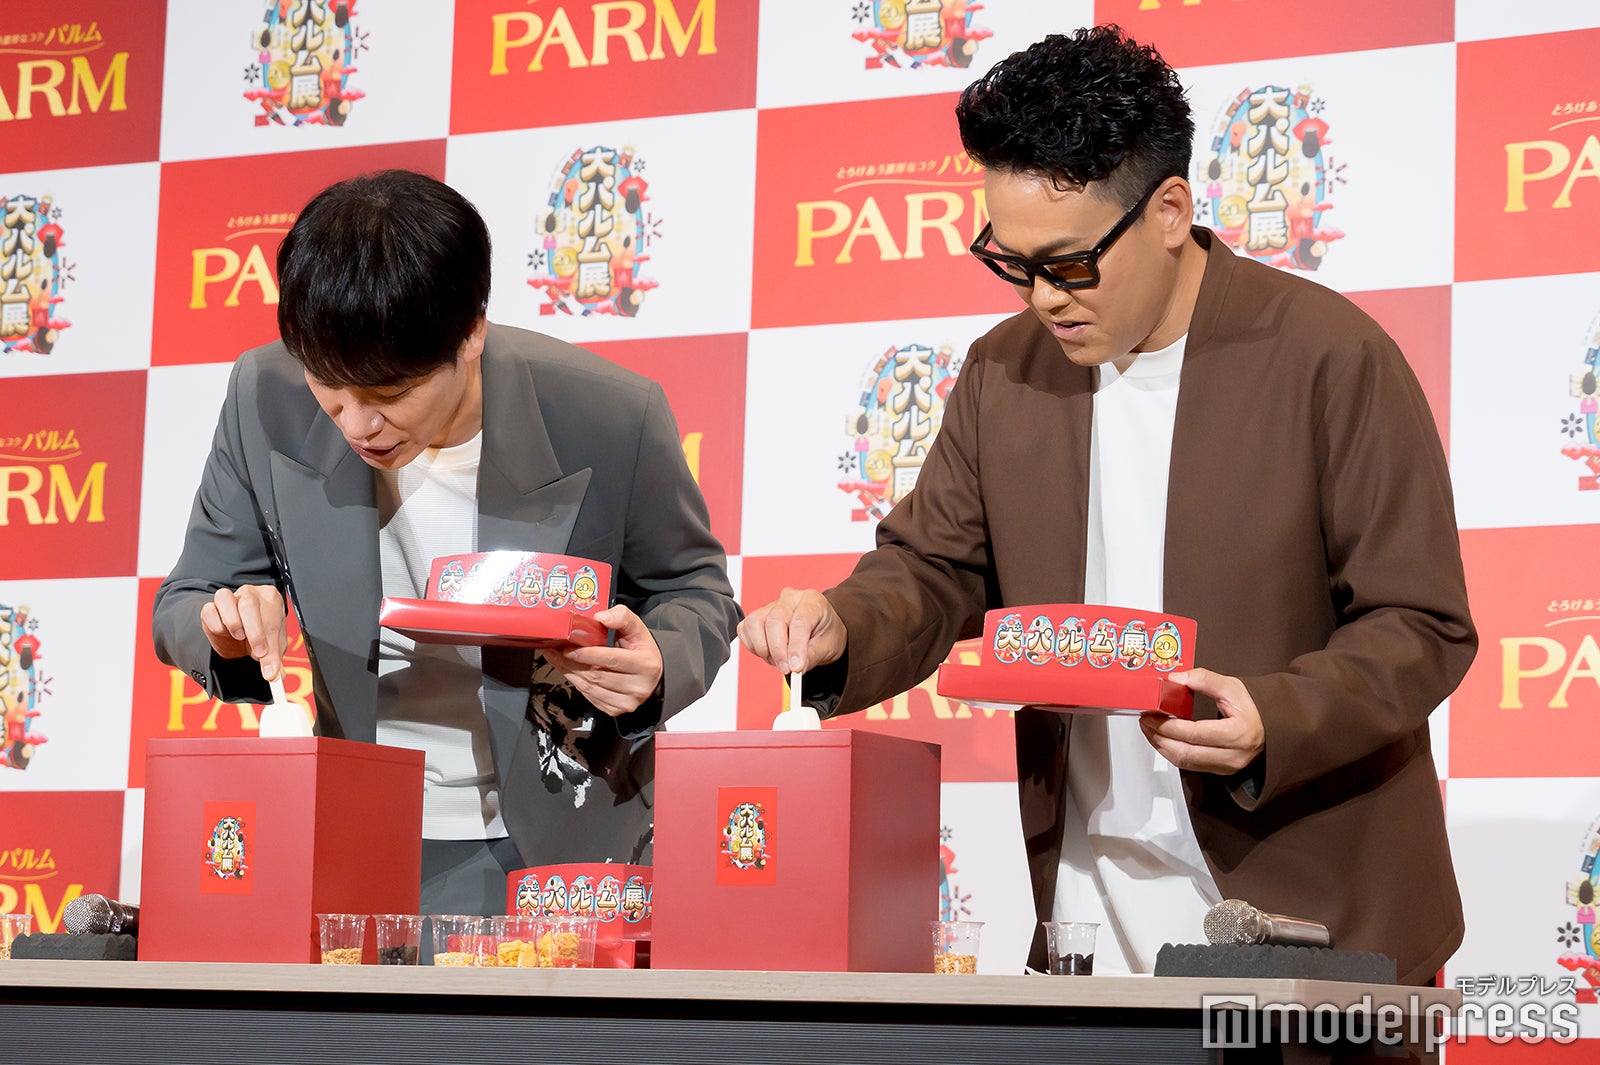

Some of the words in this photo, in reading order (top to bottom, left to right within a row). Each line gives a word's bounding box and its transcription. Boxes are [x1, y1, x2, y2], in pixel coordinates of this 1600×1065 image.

[45, 21, 102, 46] パルム
[489, 0, 718, 76] PARM
[0, 52, 129, 122] RM
[1247, 86, 1290, 252] 大パルム展
[576, 147, 616, 299] 大パルム展
[0, 196, 36, 337] 大パルム展
[22, 429, 80, 452] パルム
[997, 627, 1147, 657] 大パルム展
[519, 886, 646, 912] 大パルム展
